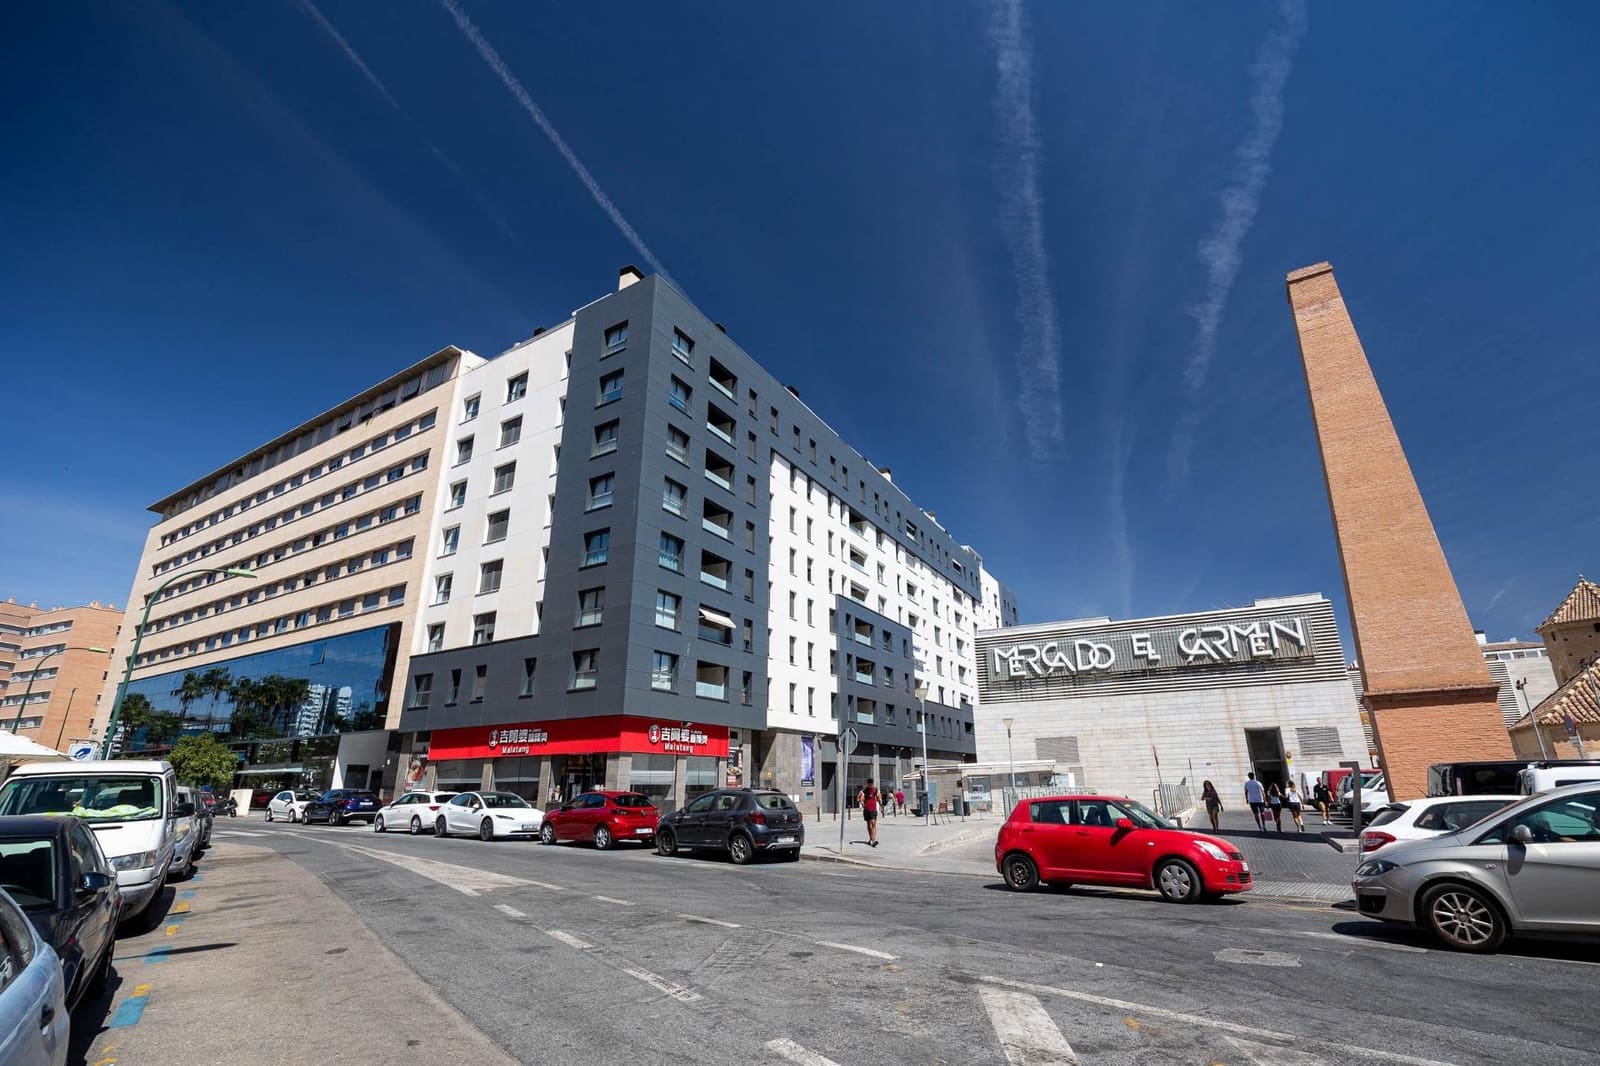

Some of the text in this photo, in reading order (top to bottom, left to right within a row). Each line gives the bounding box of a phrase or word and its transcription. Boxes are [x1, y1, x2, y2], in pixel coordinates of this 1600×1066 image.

[994, 617, 1306, 676] MERCADO EL CARMEN
[502, 746, 529, 754] Malatang
[664, 742, 694, 753] Malatang
